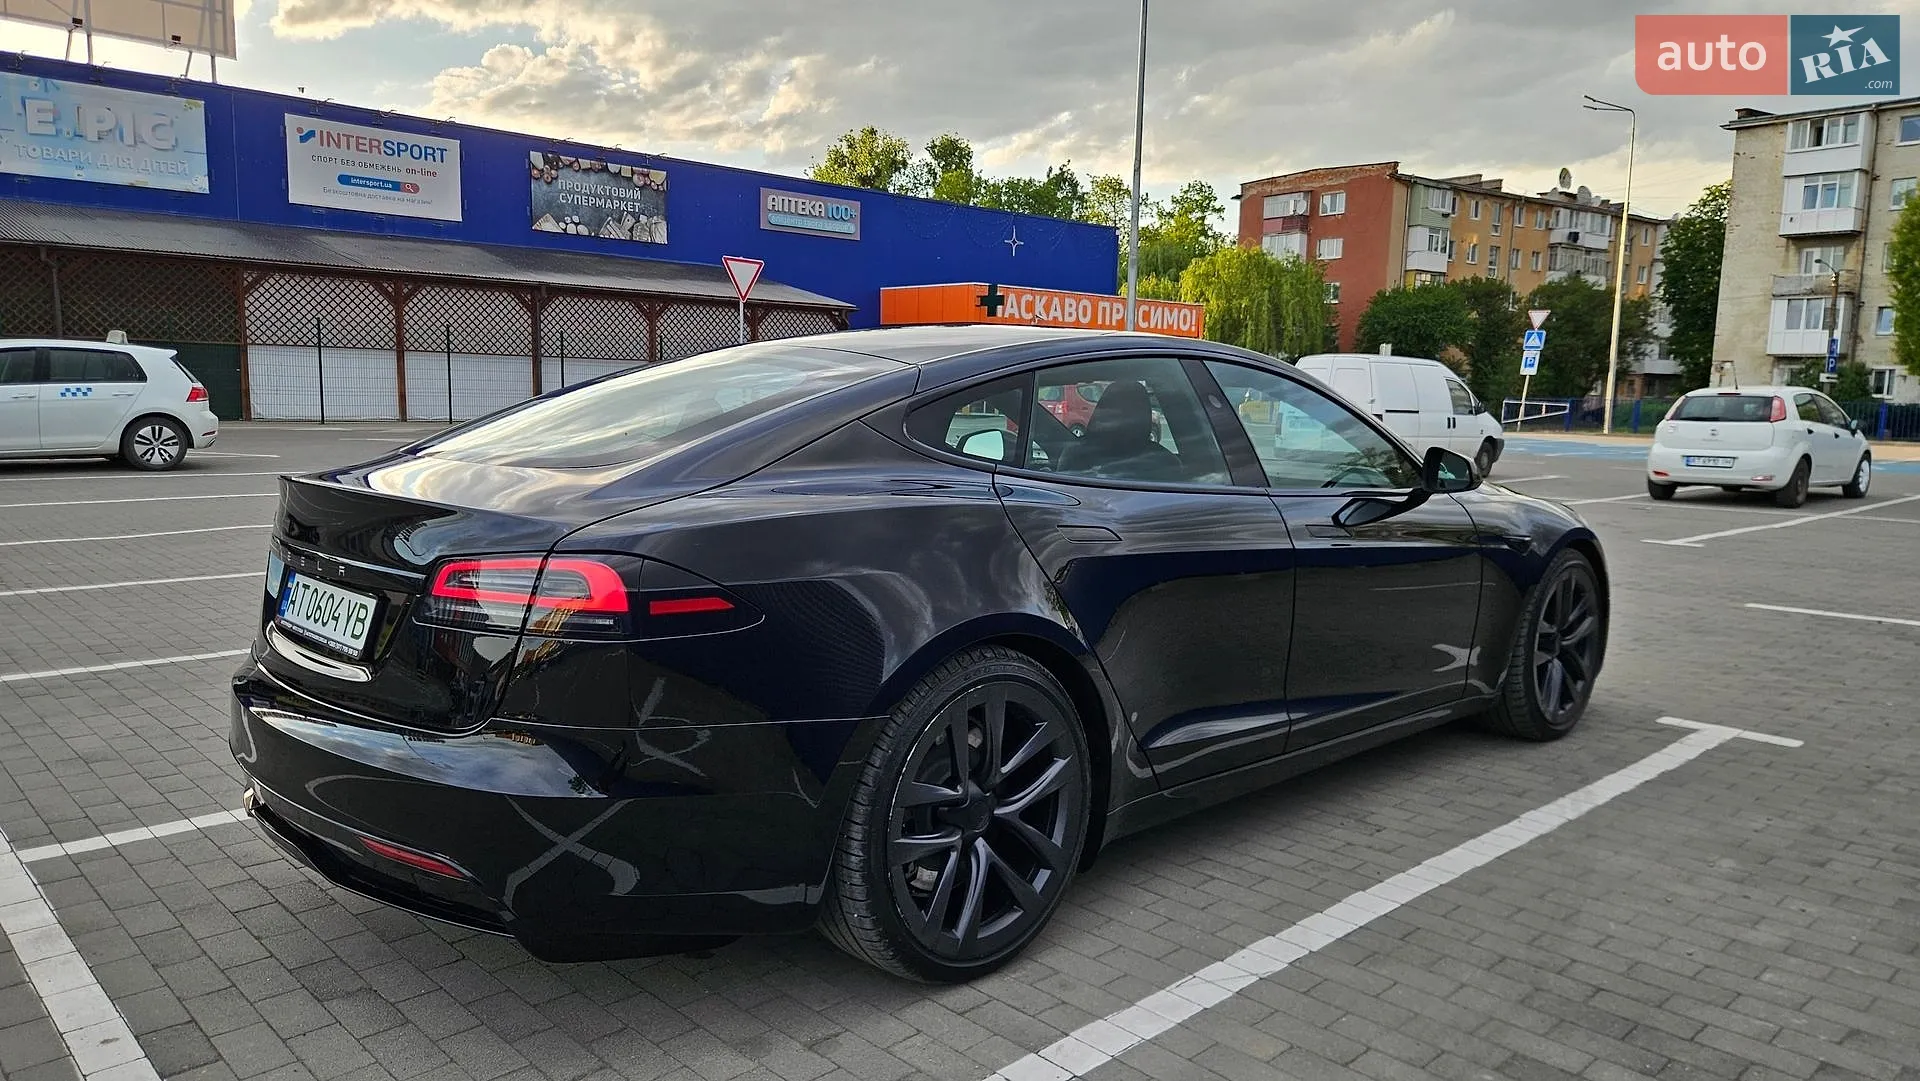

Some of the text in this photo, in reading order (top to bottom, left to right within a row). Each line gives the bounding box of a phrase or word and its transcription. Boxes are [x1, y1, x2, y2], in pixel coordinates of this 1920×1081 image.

[319, 129, 448, 164] INTERSPORT
[14, 143, 189, 177] ТОВАРИ ДЛЯ ДІТЕЙ
[311, 154, 438, 178] СПОРТ БЕЗ ОБМЕЖЕНЬ on-line
[350, 177, 393, 190] intersport.ua
[558, 179, 641, 200] ПРОДУКТОВИЙ
[559, 193, 641, 213] СУПЕРМАРКЕТ
[767, 194, 825, 218] АПТЕКА
